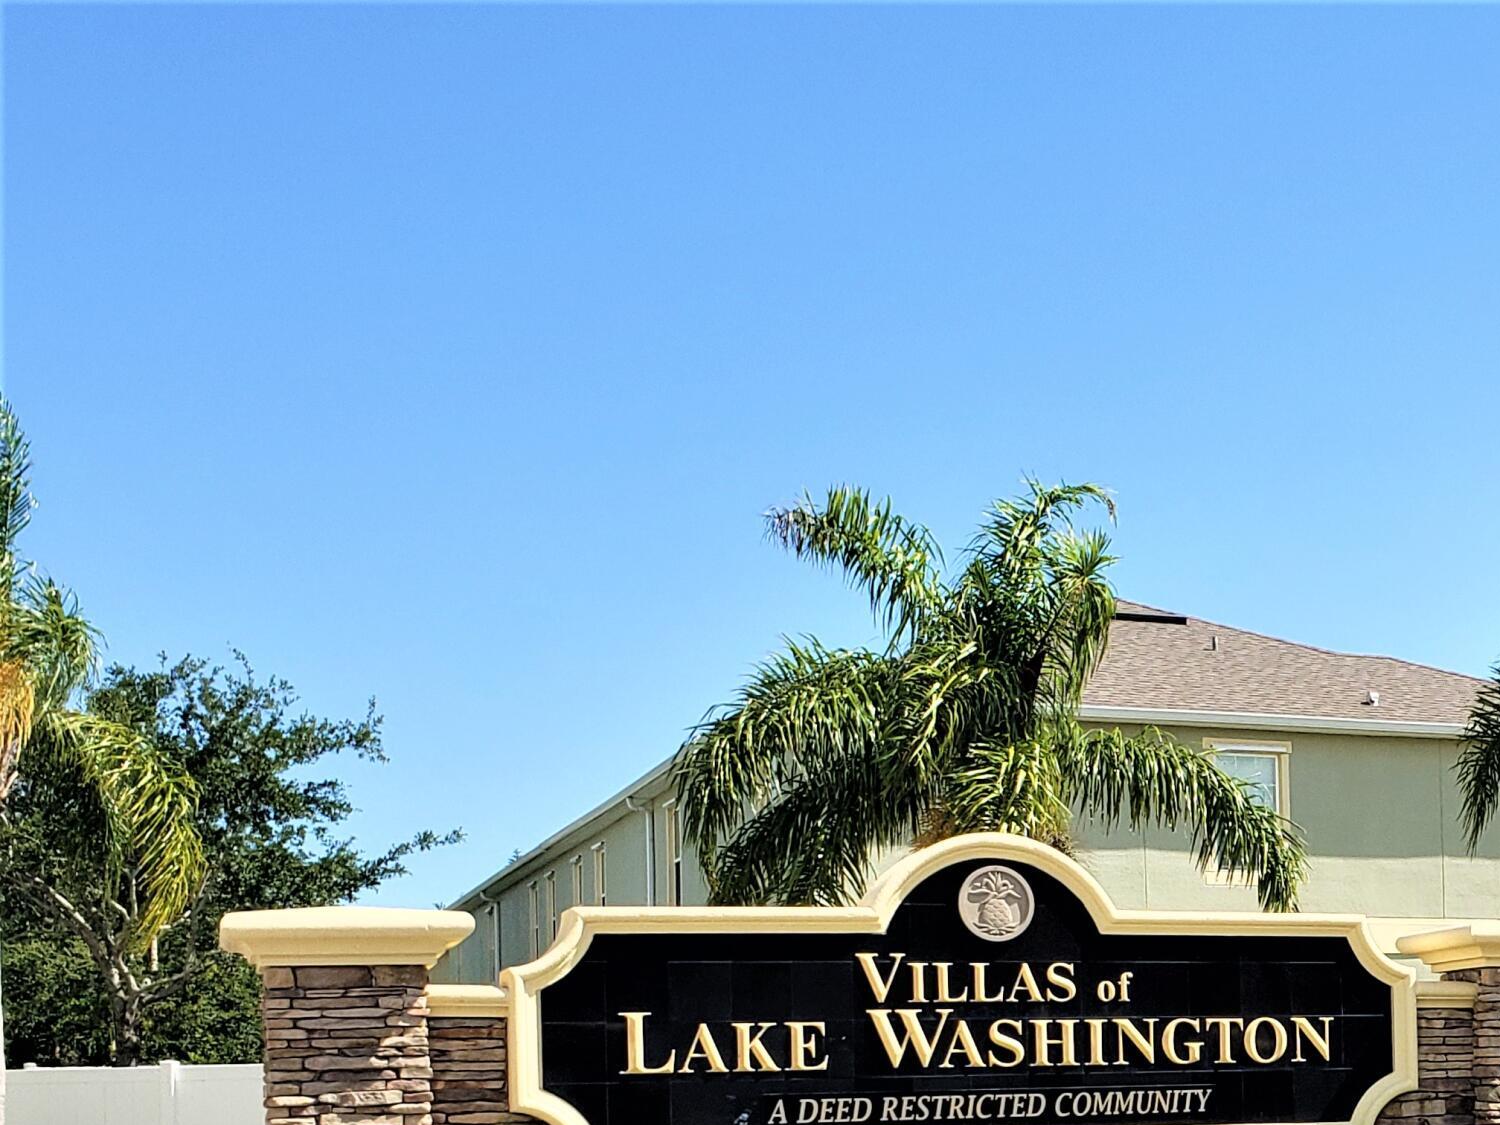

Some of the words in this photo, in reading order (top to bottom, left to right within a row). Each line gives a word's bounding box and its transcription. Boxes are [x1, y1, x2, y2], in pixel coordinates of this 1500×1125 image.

[855, 953, 1076, 1004] VILLAS
[1098, 972, 1133, 1003] of
[618, 1012, 829, 1074] LAKE
[866, 1009, 1334, 1068] WASHINGTON
[767, 1099, 788, 1125] A
[796, 1097, 873, 1124] DEED
[880, 1093, 1046, 1122] RESTRICTED
[1054, 1088, 1213, 1117] COMMUNITY
